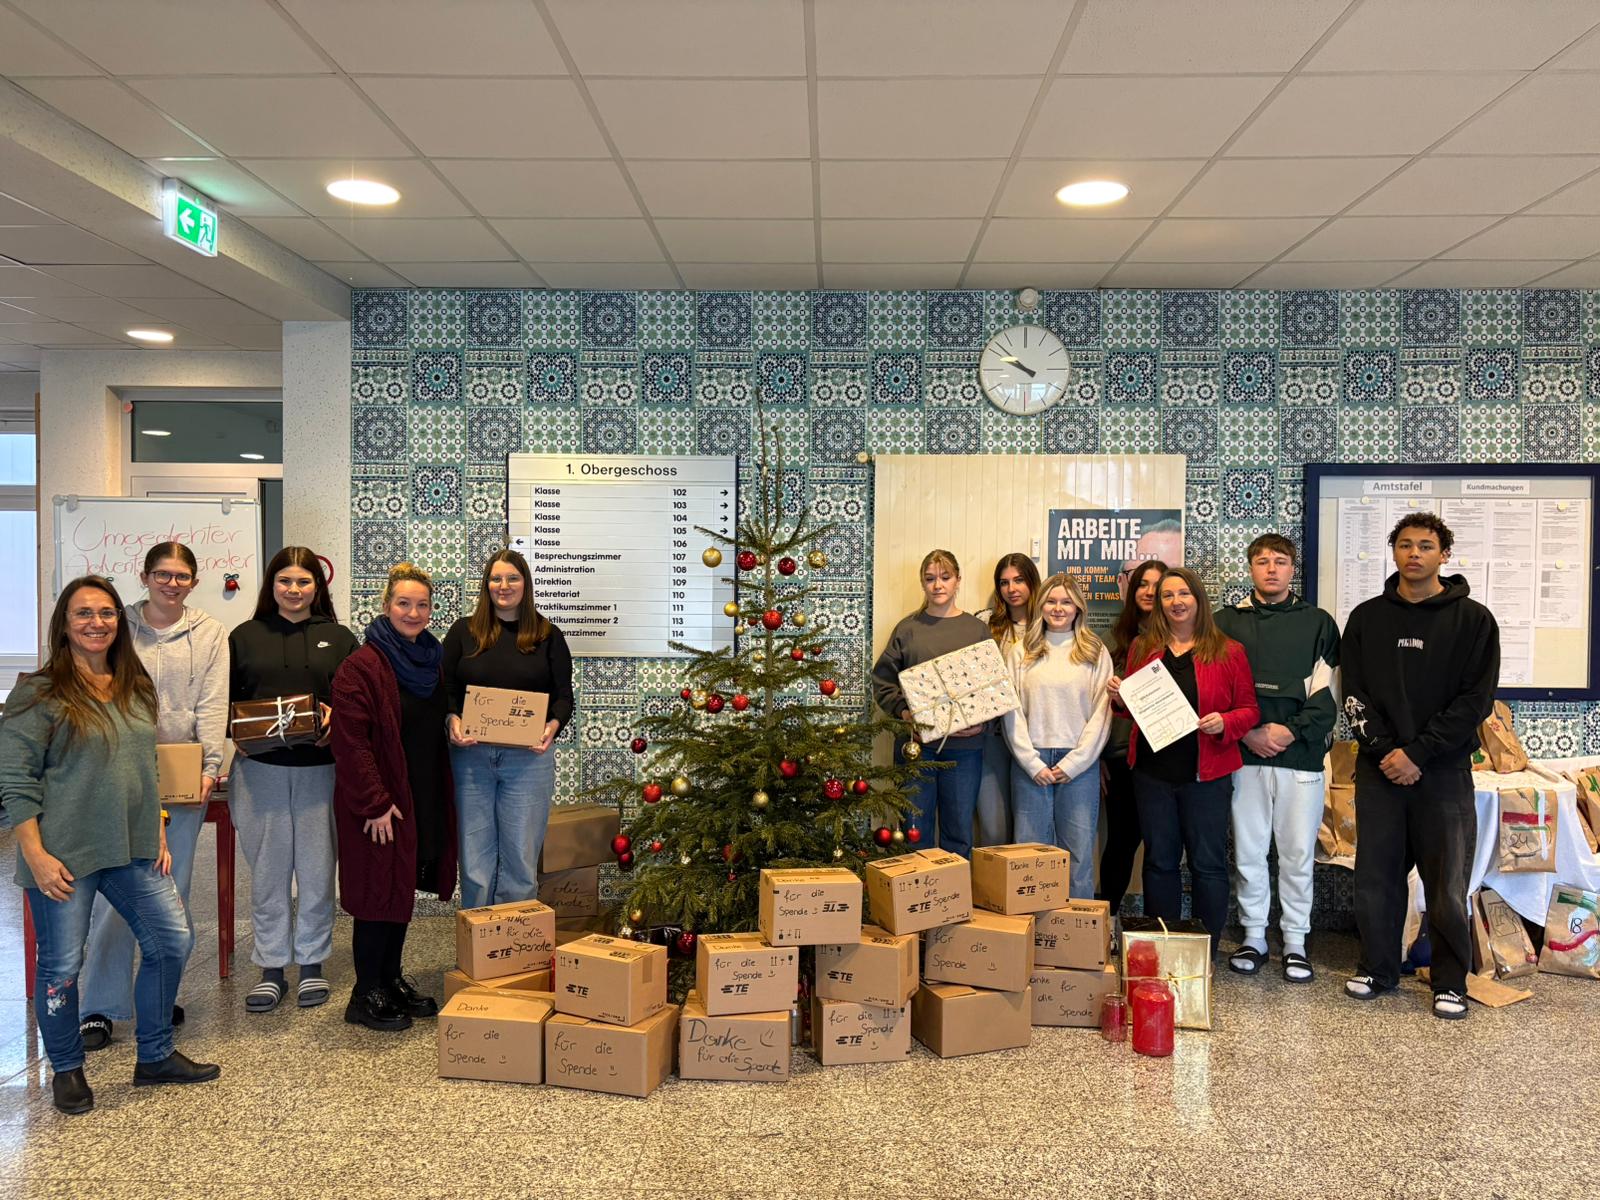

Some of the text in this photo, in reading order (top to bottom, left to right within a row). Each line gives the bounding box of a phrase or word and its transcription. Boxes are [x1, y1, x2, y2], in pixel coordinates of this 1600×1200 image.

[566, 463, 678, 477] 1. Obergeschoss
[1373, 481, 1423, 491] Amtstafel
[1466, 484, 1524, 492] Kundmachungen
[534, 487, 687, 497] Klasse 102
[534, 500, 687, 509] Klasse 103
[534, 513, 688, 522] Klasse 104
[534, 526, 687, 535] Klasse 105
[1057, 518, 1142, 540] ARBEITE
[534, 538, 688, 548] Klasse 106
[1057, 540, 1093, 561] MIT
[534, 552, 686, 562] Besprechungszimmer 107
[534, 565, 687, 574] Administration 108
[1066, 566, 1082, 574] UND
[534, 577, 687, 587] Direktion 109
[1095, 575, 1116, 583] TEAM
[534, 590, 685, 599] Sekretariat 110
[1095, 592, 1120, 600] ETWAS
[534, 603, 611, 611] Praktikumszimmer
[672, 604, 684, 612] 111
[549, 615, 684, 625] ktikumszimmer 2 113
[562, 629, 684, 638] enzzimmer 114
[512, 695, 527, 706] die
[480, 712, 515, 728] Spende
[1022, 874, 1034, 882] die
[1038, 880, 1059, 892] Spende
[811, 888, 825, 898] die
[924, 888, 939, 898] die
[933, 891, 961, 907] Spende
[778, 906, 808, 917] Spende
[1050, 916, 1065, 925] die
[1570, 917, 1583, 934] 18
[1034, 931, 1059, 941] pende
[970, 941, 988, 953] die
[740, 957, 756, 968] die
[932, 953, 967, 971] Spende
[732, 970, 763, 982] Spende
[1029, 977, 1051, 985] anke
[1037, 993, 1054, 1003] die
[857, 1010, 873, 1021] die
[1059, 1005, 1094, 1018] Spende
[483, 1029, 500, 1041] die
[687, 1018, 753, 1052] Danke
[861, 1023, 894, 1037] Spende
[595, 1040, 614, 1055] die
[447, 1047, 487, 1065] Spende
[557, 1057, 598, 1077] Spende
